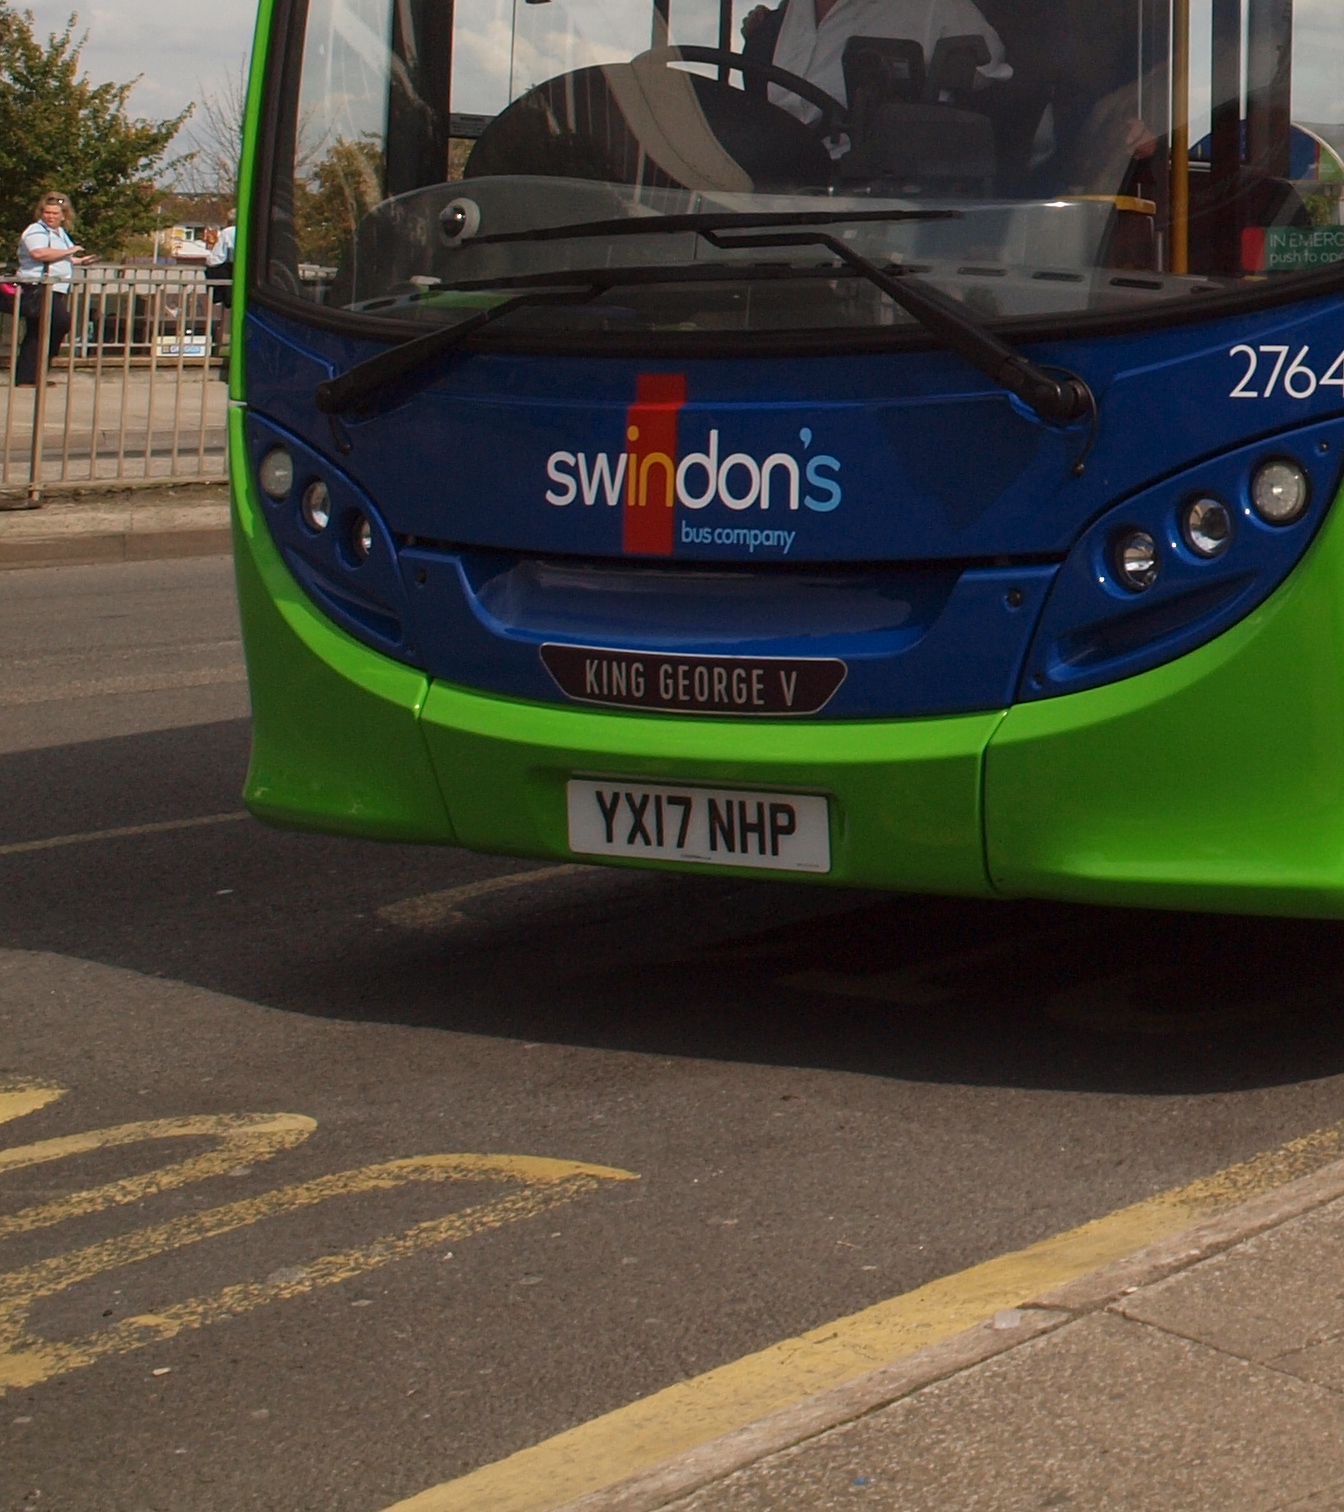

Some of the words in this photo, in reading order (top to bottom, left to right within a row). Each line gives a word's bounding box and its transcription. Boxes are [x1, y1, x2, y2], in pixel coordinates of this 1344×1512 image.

[1269, 233, 1286, 248] IN
[1269, 249, 1302, 267] push
[1303, 249, 1318, 263] to
[544, 424, 843, 512] swindon's
[680, 520, 711, 544] bus
[714, 526, 796, 555] company
[585, 659, 646, 698] KING
[658, 662, 765, 706] GEORGE
[779, 669, 798, 707] V
[595, 789, 693, 850] YX17
[707, 797, 797, 857] NHP
